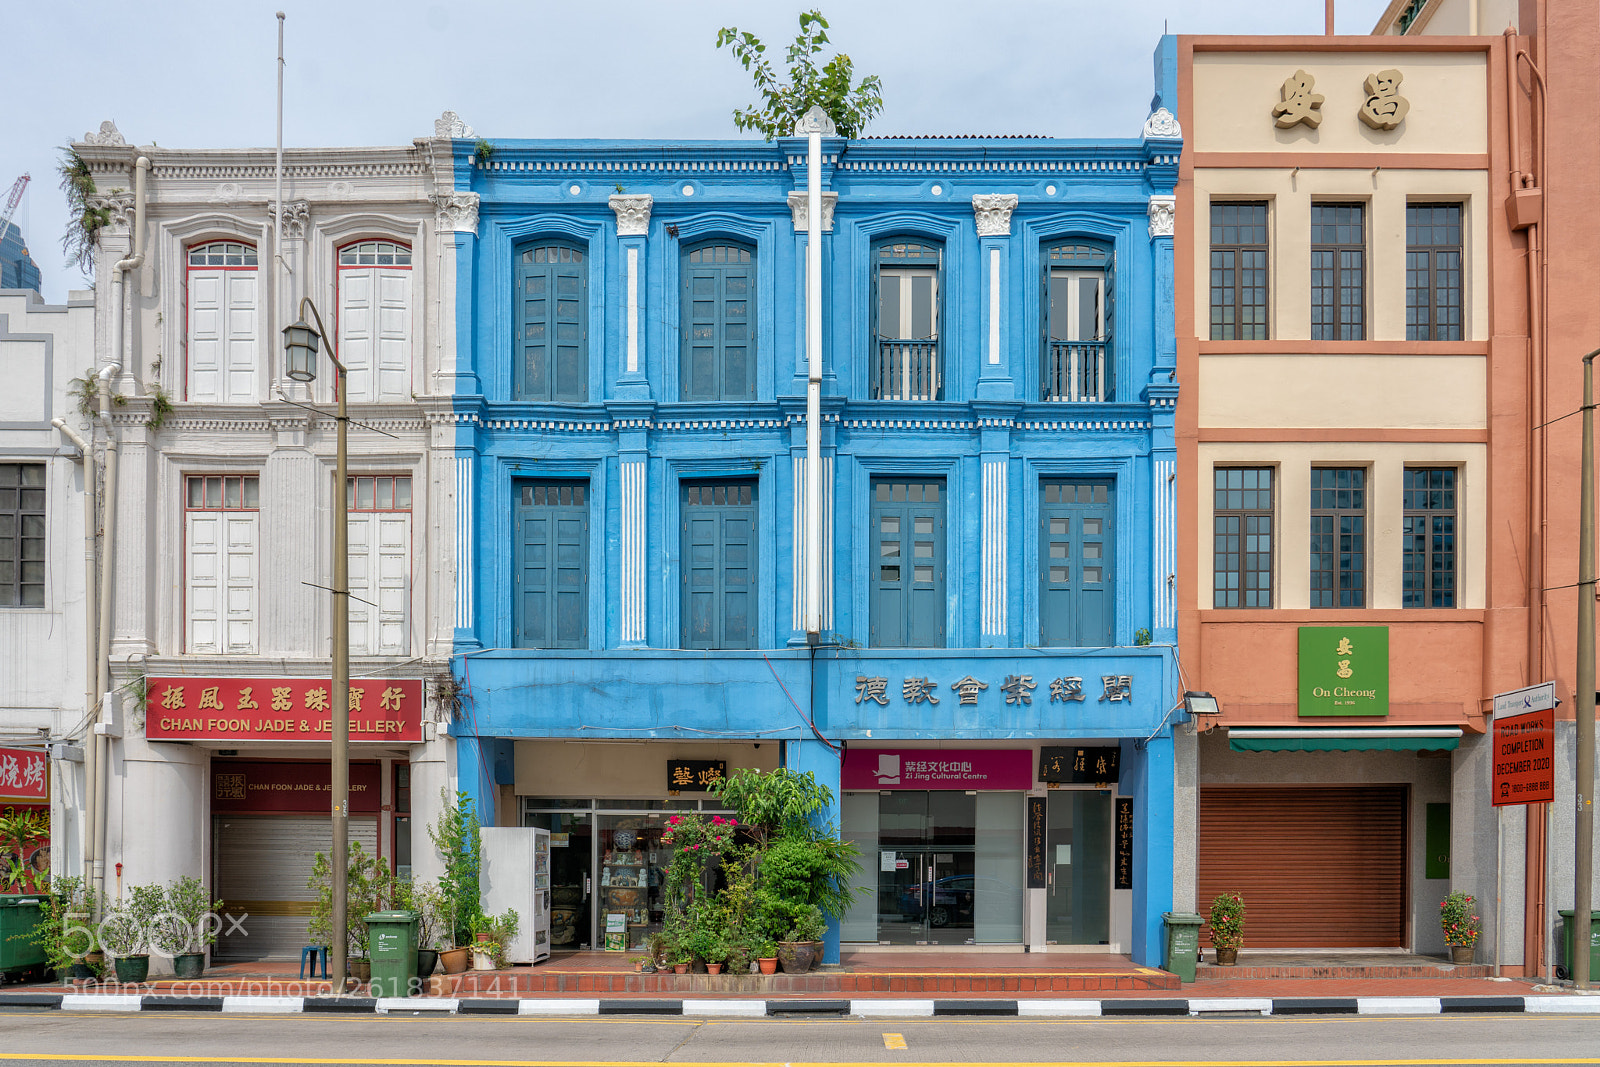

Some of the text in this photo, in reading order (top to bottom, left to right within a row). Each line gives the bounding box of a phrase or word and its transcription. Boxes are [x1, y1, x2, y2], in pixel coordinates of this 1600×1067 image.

[1313, 687, 1376, 699] On Cheong
[160, 717, 406, 733] CHAN FOON JADE & JEELLERY
[1501, 719, 1544, 738] ROAD WORKS
[1501, 738, 1544, 755] COMPLETION
[905, 761, 972, 772] 紫经文化中心
[1497, 757, 1550, 775] DECEMBER 2020
[914, 773, 930, 781] Jing
[248, 783, 270, 791] CHAN
[271, 783, 293, 791] FOON
